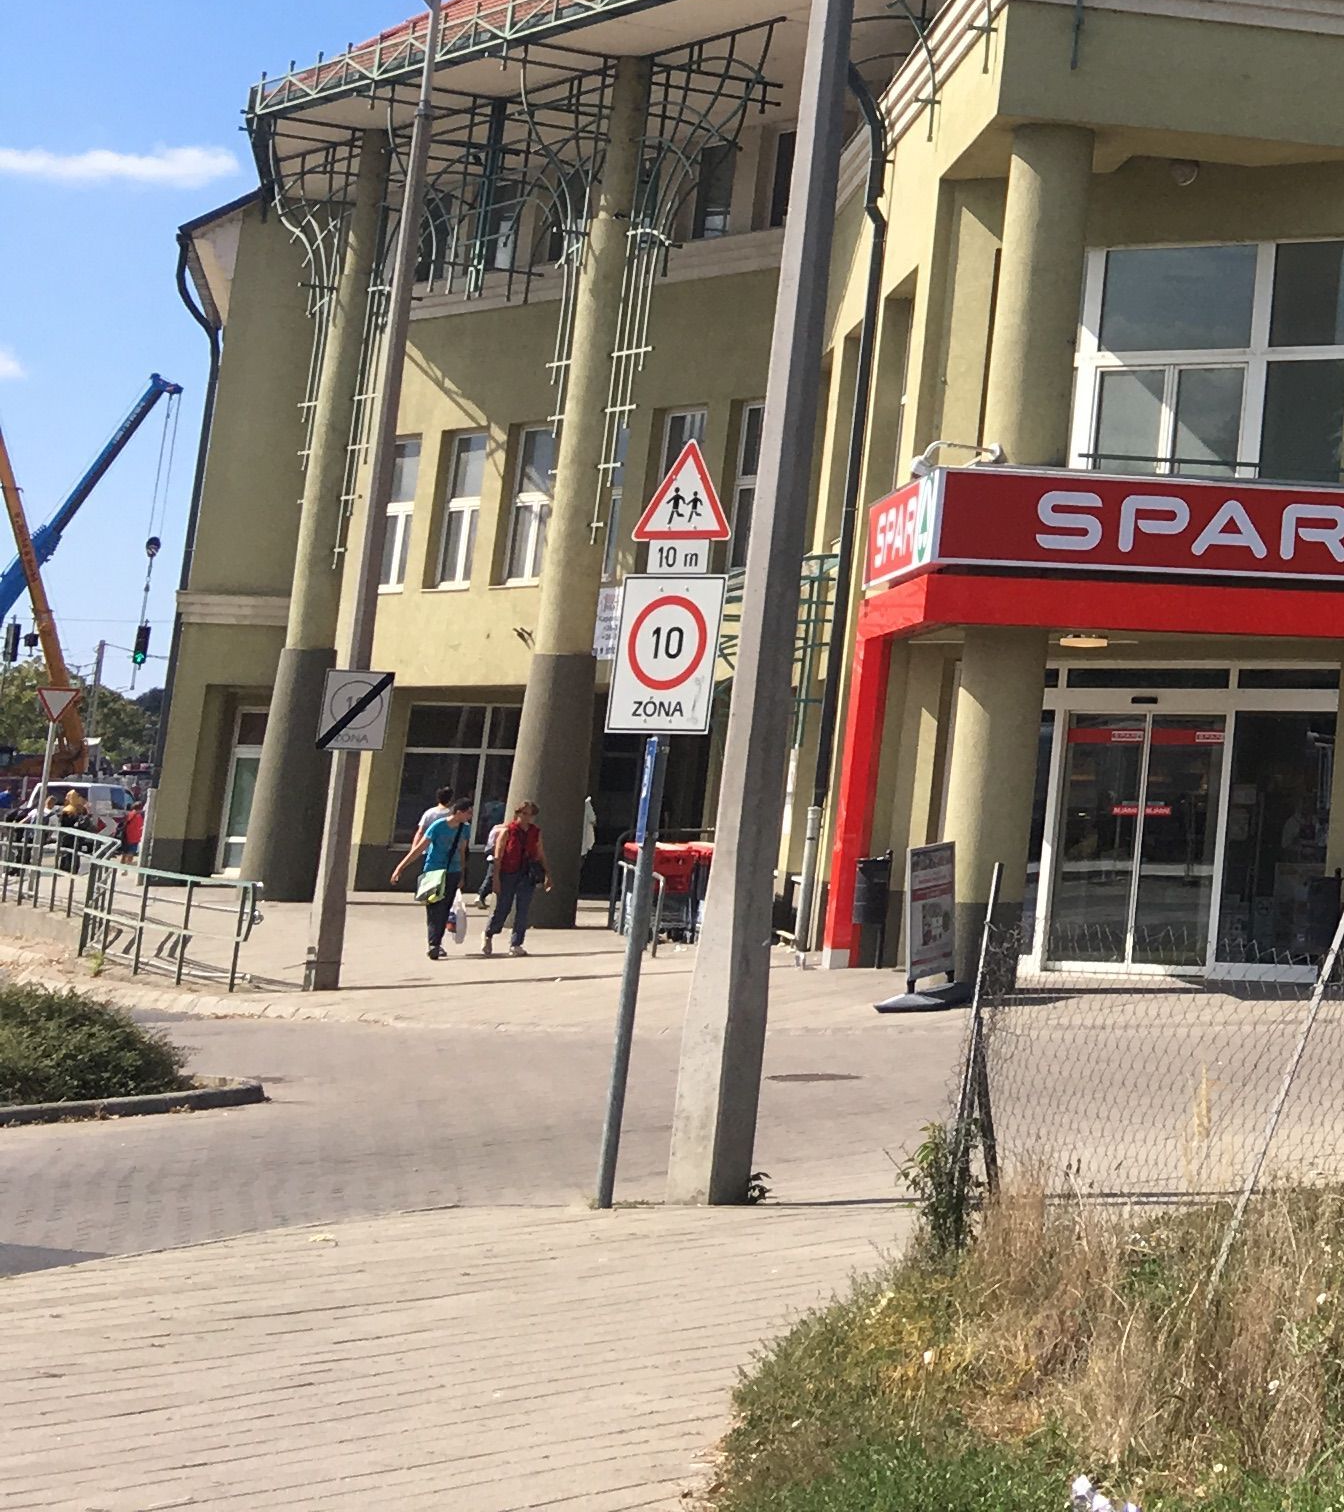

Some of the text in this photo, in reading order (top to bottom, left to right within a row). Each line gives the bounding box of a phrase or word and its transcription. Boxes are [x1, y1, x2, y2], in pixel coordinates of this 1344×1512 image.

[874, 496, 917, 568] SPAR
[657, 546, 699, 568] 10 m
[652, 626, 684, 659] 10
[632, 696, 684, 717] ZÓNA
